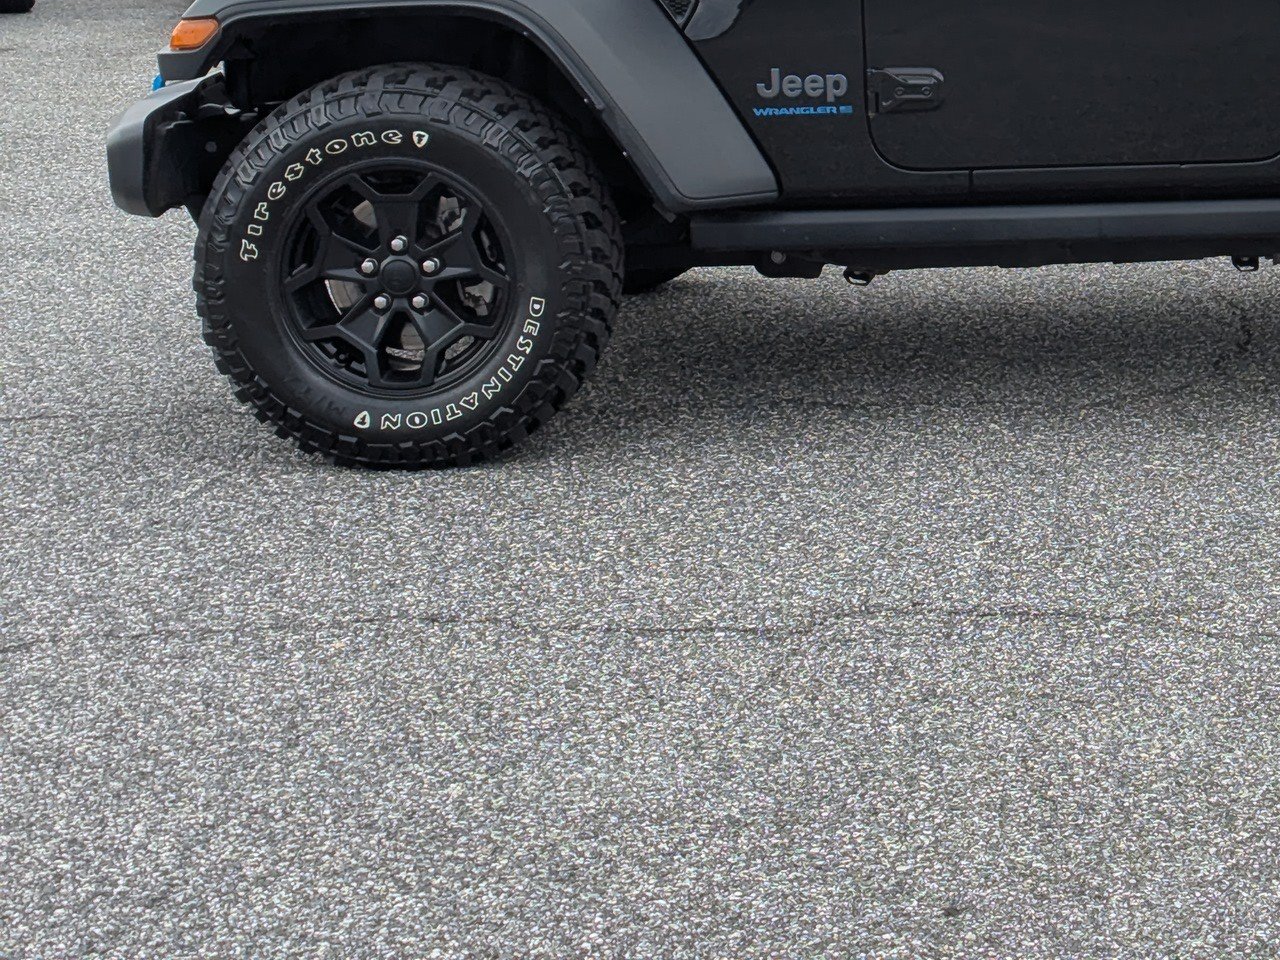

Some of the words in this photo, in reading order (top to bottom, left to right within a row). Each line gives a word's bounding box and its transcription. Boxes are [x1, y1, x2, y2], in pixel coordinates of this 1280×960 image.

[753, 105, 837, 116] WRANGLER
[756, 68, 848, 102] Jeep
[240, 129, 403, 261] Firestone
[381, 296, 546, 430] DESTINATION
